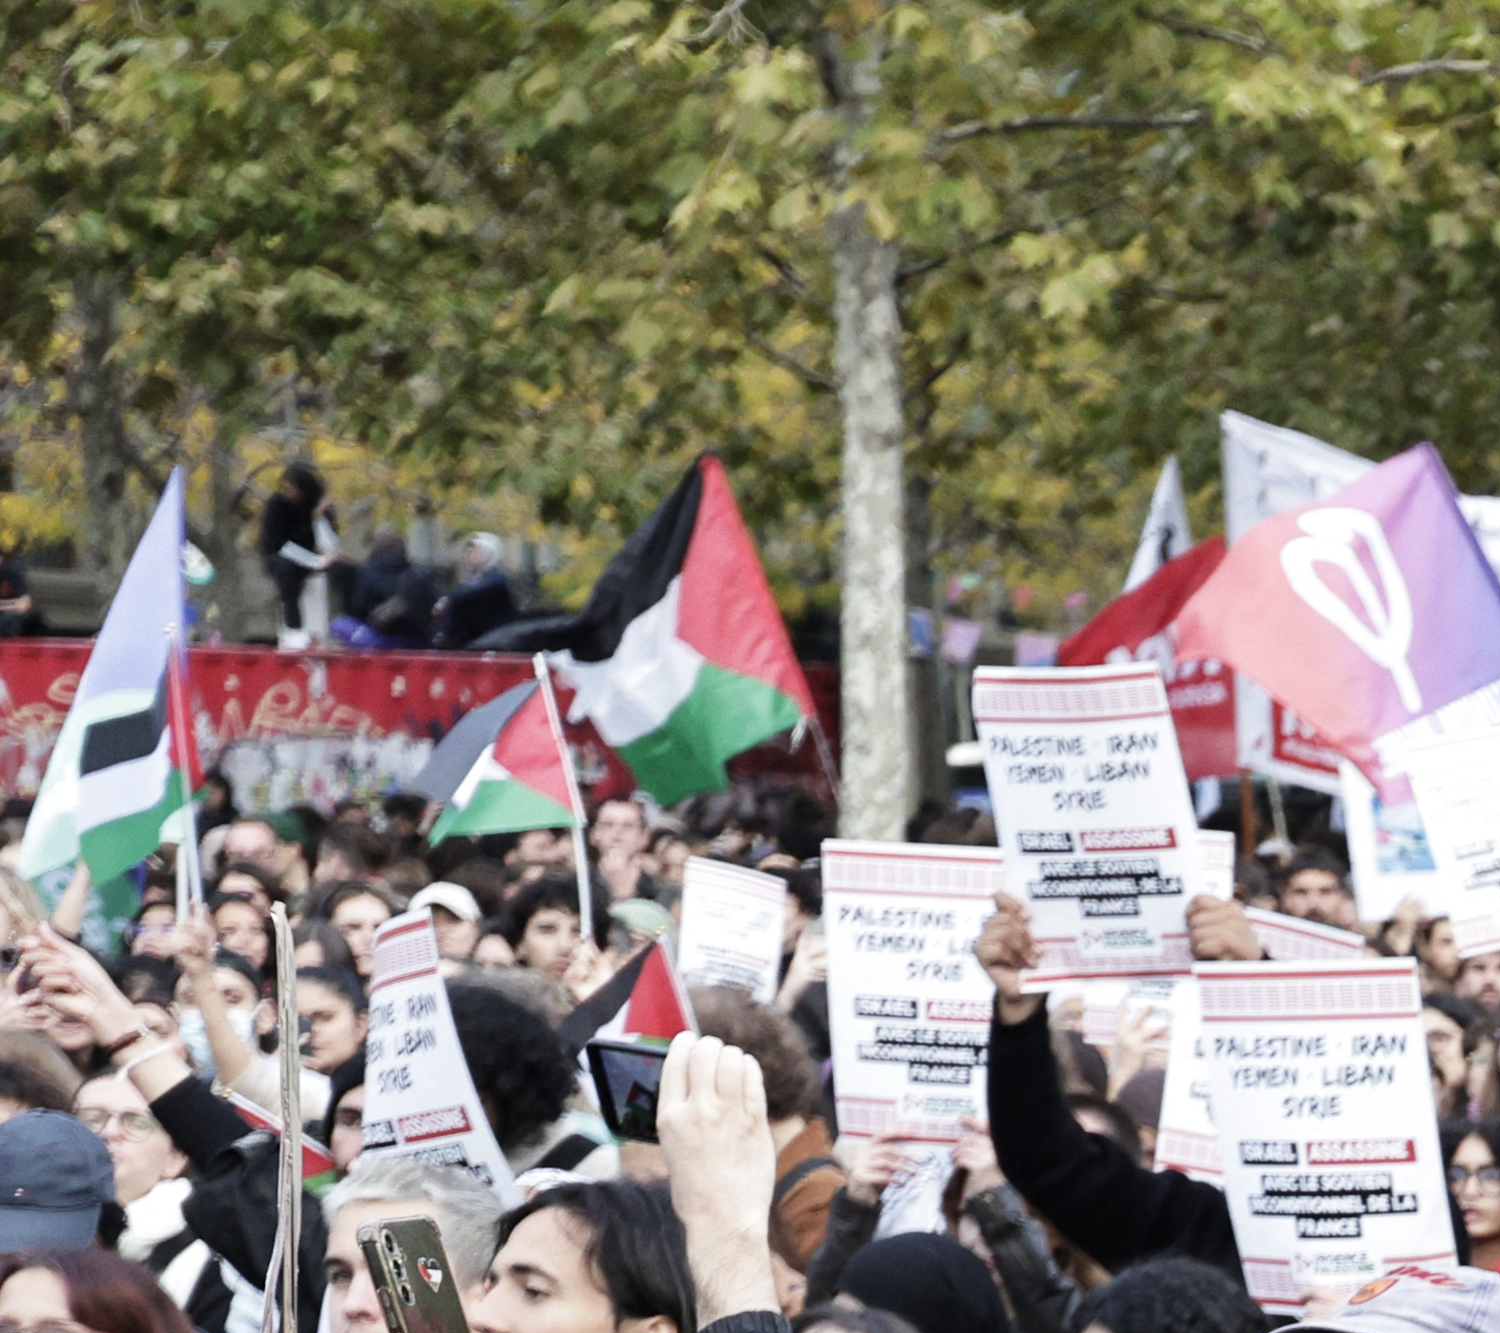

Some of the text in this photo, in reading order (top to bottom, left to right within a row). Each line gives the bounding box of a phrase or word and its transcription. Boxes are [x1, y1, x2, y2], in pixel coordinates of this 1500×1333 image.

[990, 733, 1085, 757] PALESTINE
[838, 905, 955, 930] PALESTINE
[852, 934, 925, 954] YEMEN
[905, 959, 965, 982] SYRIE
[1215, 1034, 1408, 1059] PALESTINE IRAN
[1231, 1064, 1395, 1088] YEMEN LIBAN
[1283, 1095, 1342, 1119] SYRIE
